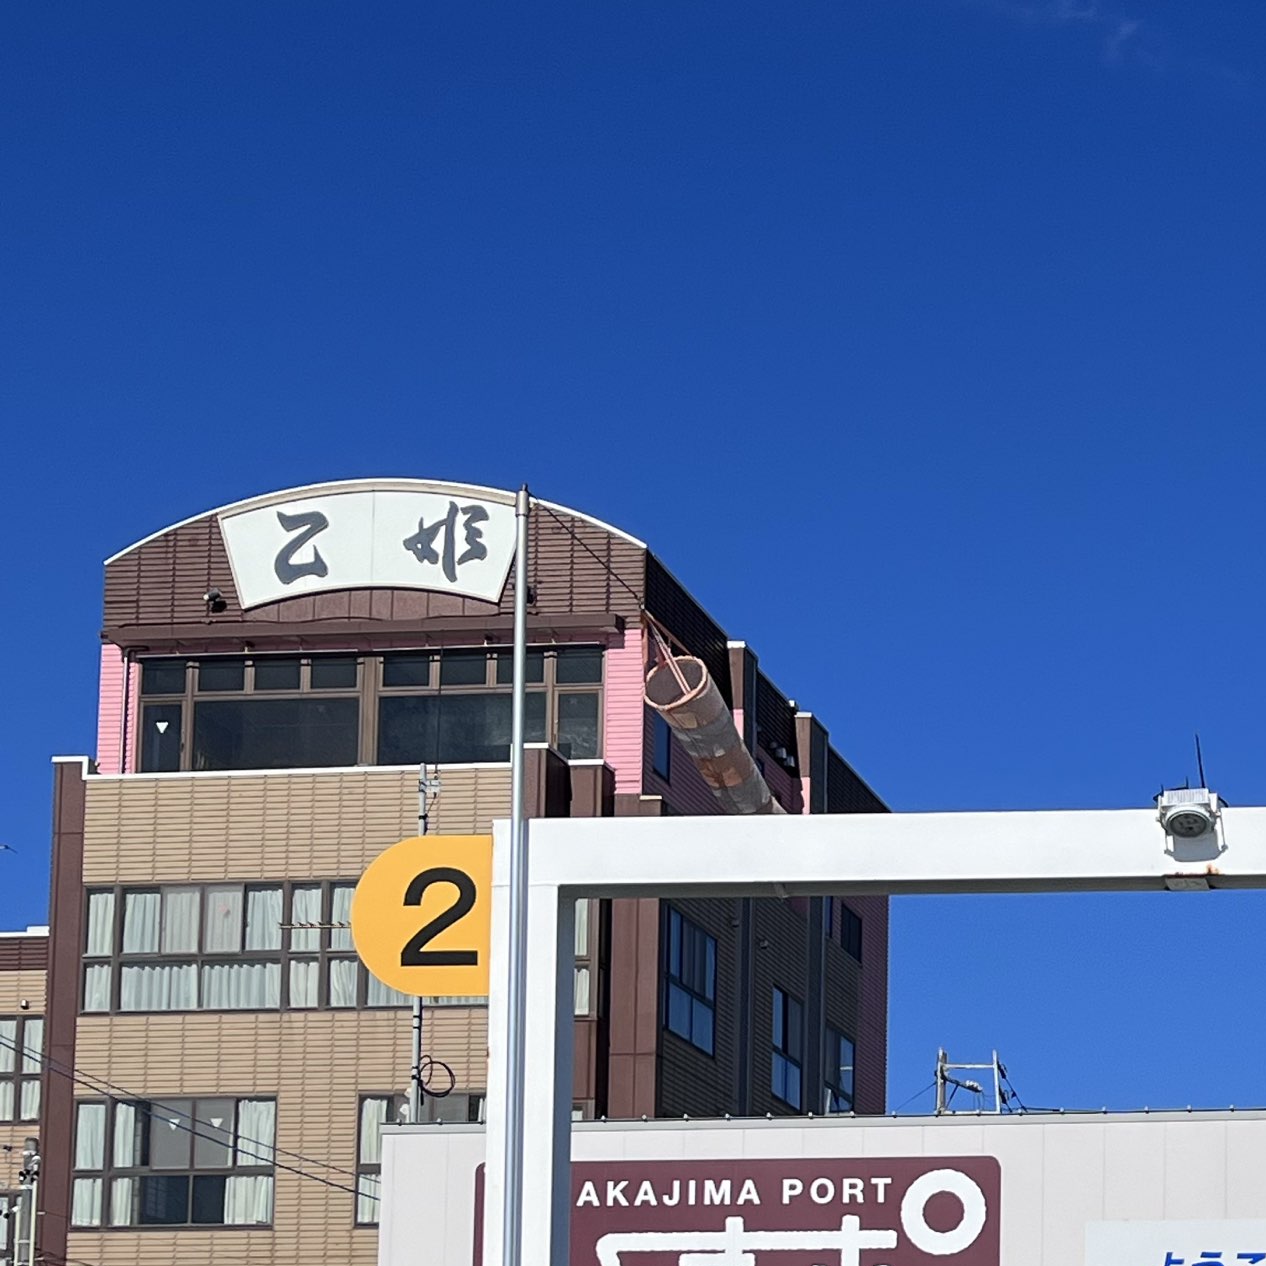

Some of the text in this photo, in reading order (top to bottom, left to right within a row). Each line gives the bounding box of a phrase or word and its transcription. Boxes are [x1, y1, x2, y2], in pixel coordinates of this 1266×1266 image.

[400, 867, 478, 966] 2
[576, 1177, 893, 1207] AKAJIMA PORT
